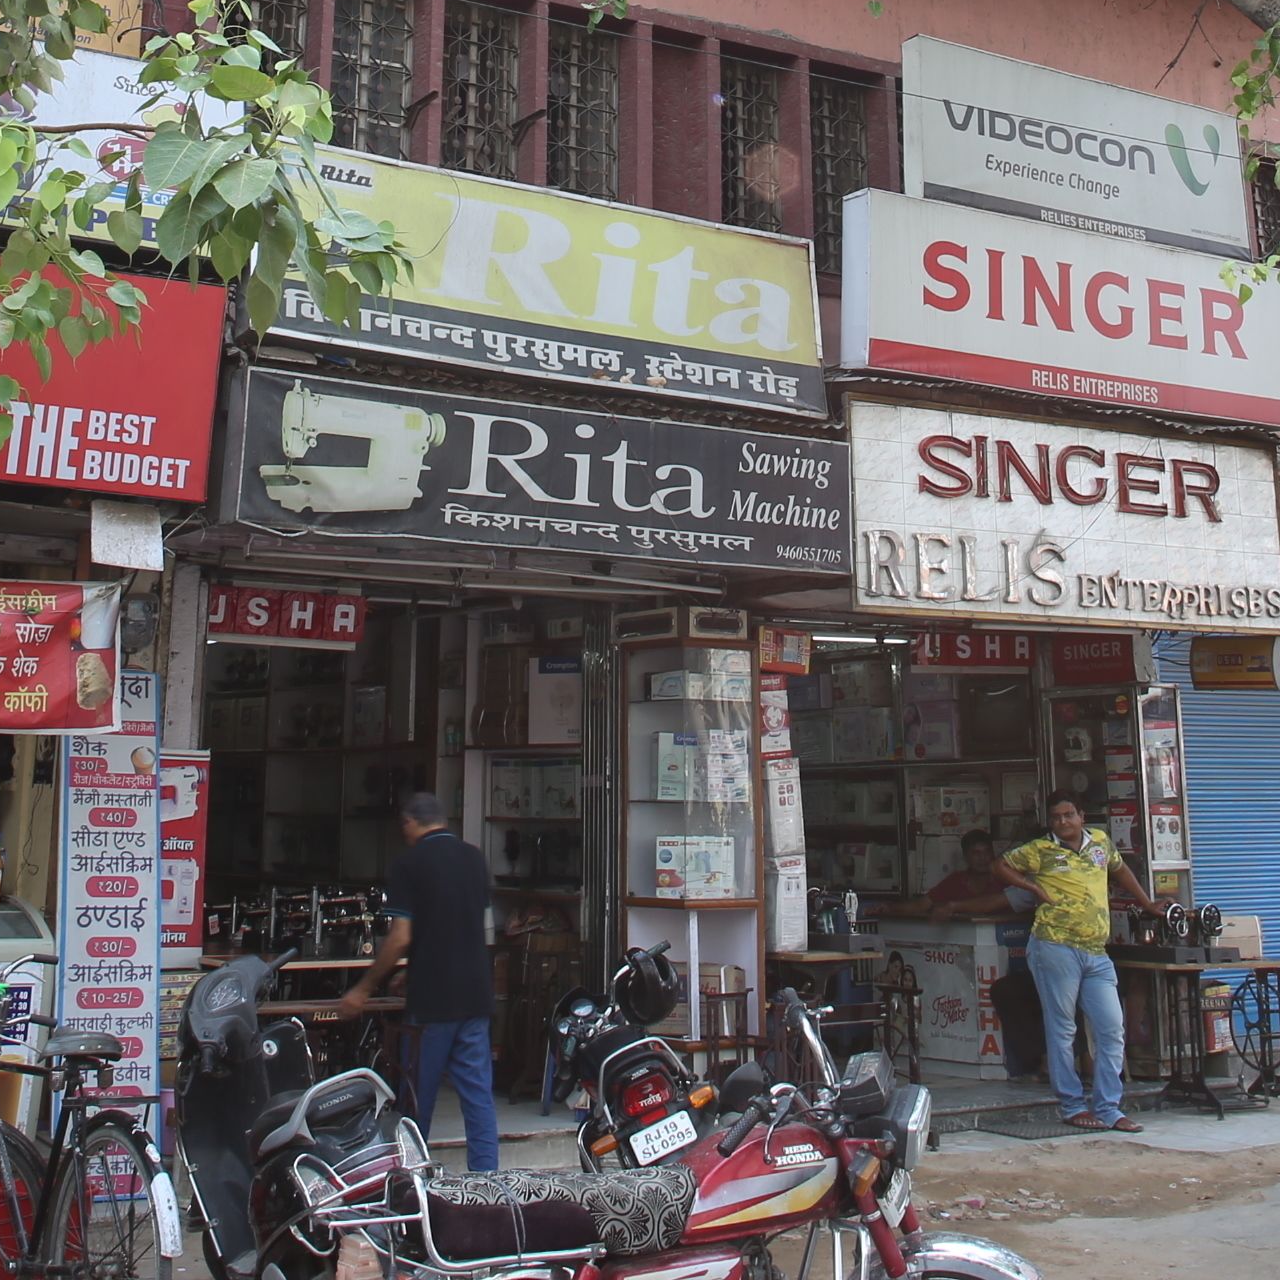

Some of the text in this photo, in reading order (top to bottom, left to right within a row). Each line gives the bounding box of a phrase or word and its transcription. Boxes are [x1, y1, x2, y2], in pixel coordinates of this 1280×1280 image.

[320, 165, 373, 188] Rita
[985, 153, 1120, 201] Experience Change
[1040, 209, 1147, 241] RELIES ENTERPRISES
[420, 192, 799, 352] Rita
[922, 240, 1249, 361] SINGER
[1032, 369, 1159, 405] RELIS ENTREPRISES
[4, 400, 157, 482] THE BEST
[83, 449, 191, 489] BUDGET
[447, 410, 832, 519] Rita Sawing
[919, 434, 1222, 523] SINGER
[727, 489, 841, 532] Machine
[776, 543, 842, 565] 9460551705
[863, 528, 1067, 608] RELIS
[924, 634, 1031, 660] USHA
[1063, 641, 1122, 660] SINGER
[925, 950, 960, 965] SING
[319, 1092, 353, 1111] HONDA
[776, 1151, 824, 1166] HONDA
[783, 1144, 814, 1155] HERO
